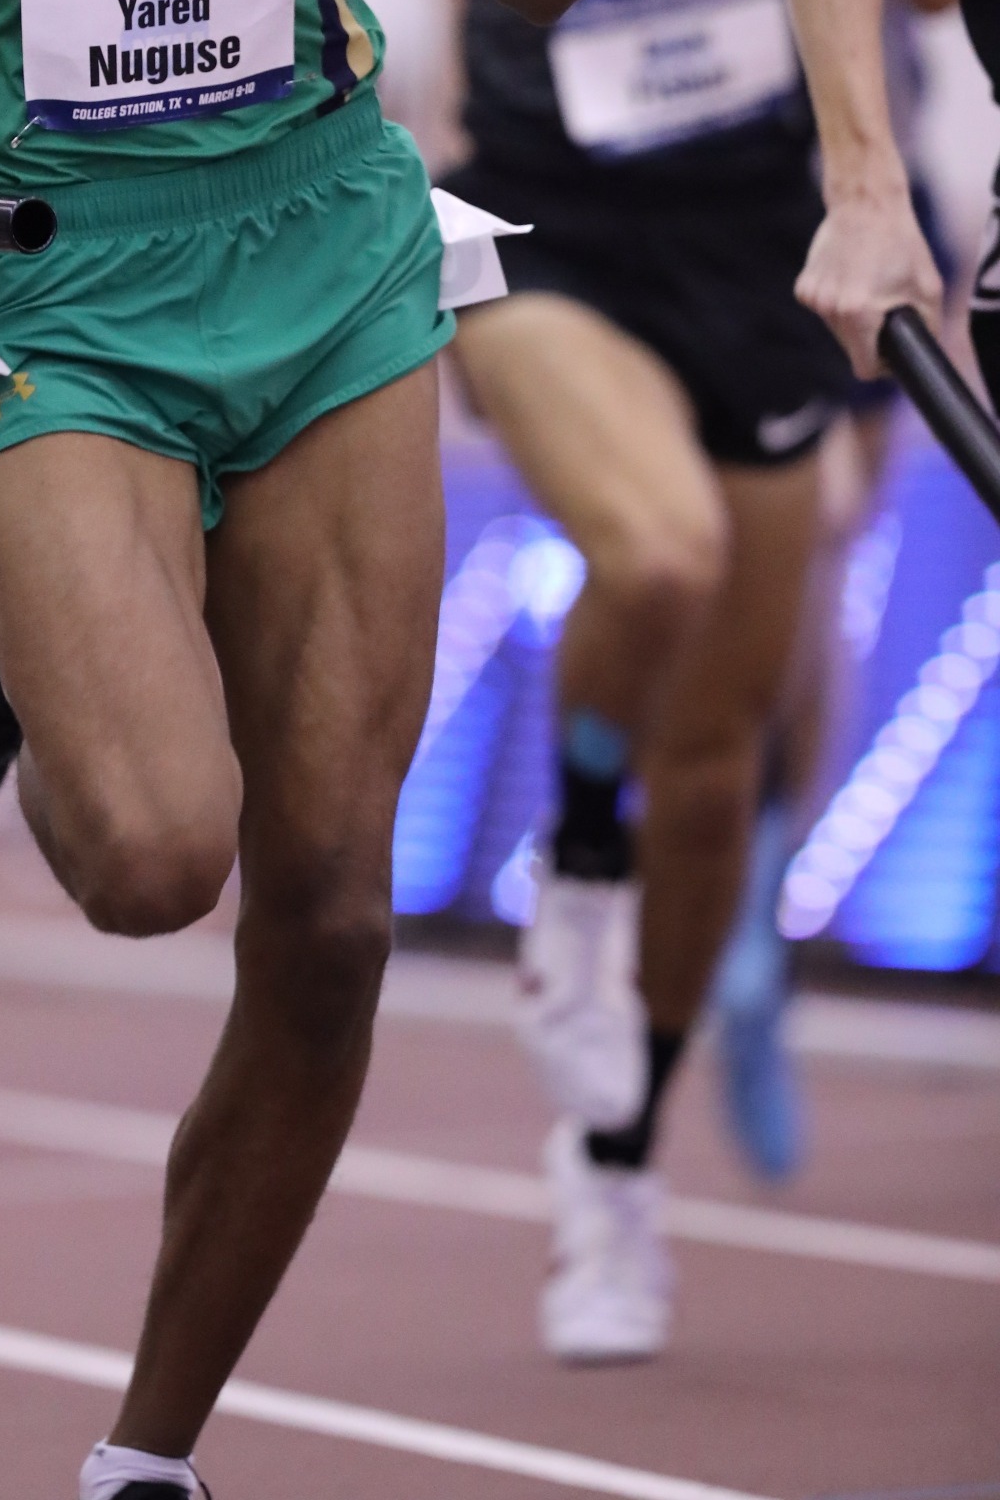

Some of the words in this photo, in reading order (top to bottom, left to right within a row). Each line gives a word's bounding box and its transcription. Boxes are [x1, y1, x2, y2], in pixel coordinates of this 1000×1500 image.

[89, 35, 241, 87] Nuguse
[72, 104, 118, 121] COLLEGE
[119, 99, 166, 118] STATION,
[168, 96, 182, 110] TX
[198, 89, 235, 106] MARCH
